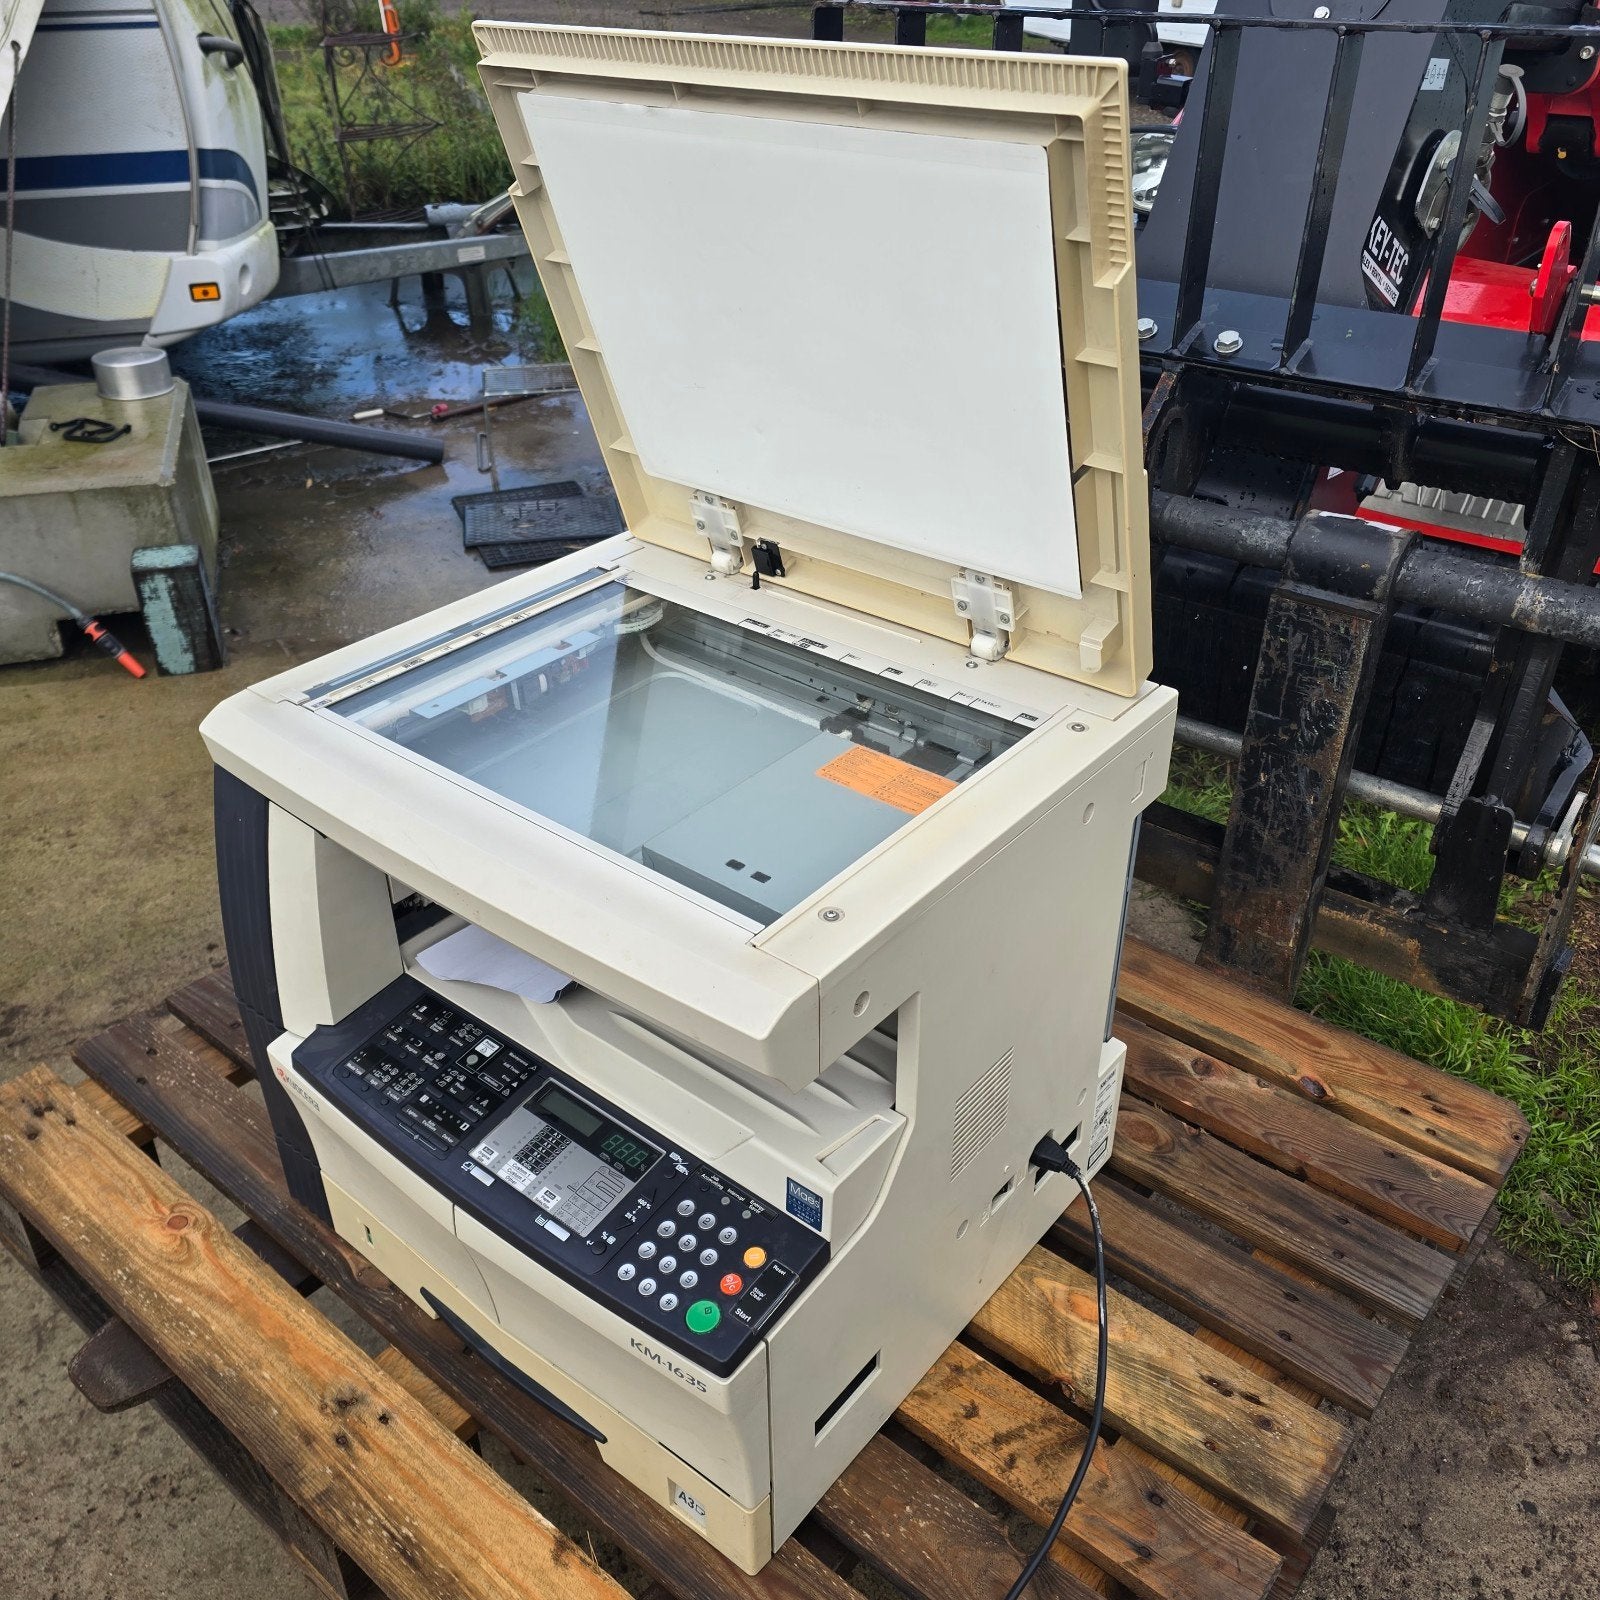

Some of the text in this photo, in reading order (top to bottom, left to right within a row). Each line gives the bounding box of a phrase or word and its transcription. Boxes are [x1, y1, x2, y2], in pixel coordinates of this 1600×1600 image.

[772, 1264, 787, 1276] Reset
[735, 1308, 752, 1322] Start
[630, 1337, 707, 1393] KM-1635
[678, 1490, 695, 1510] A3
